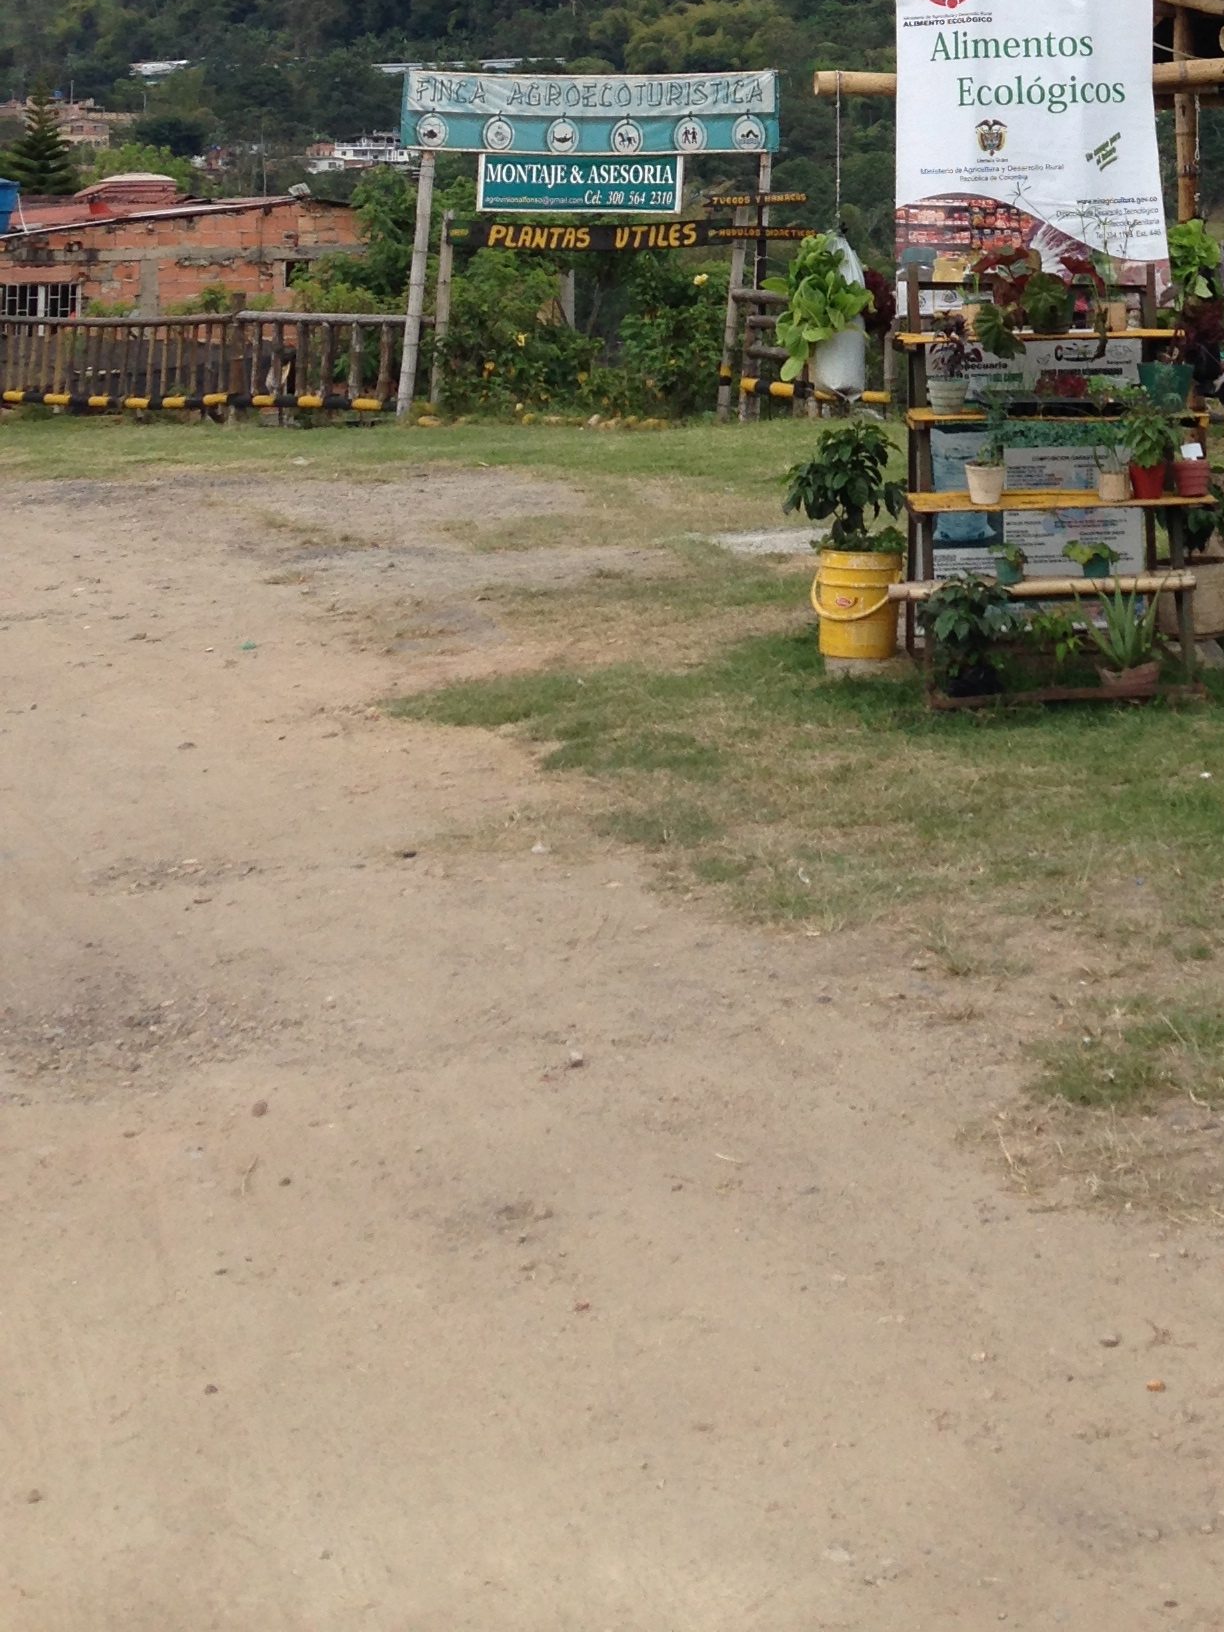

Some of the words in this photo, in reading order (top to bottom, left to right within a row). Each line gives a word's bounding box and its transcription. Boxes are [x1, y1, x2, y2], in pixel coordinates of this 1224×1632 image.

[903, 19, 945, 28] ALIMENTO
[930, 30, 1094, 61] Alimentos
[416, 76, 486, 104] FINCA
[506, 78, 763, 107] AGROECOTURISTICA
[957, 75, 1126, 114] Ecológicos
[486, 163, 567, 188] MONTAJE
[570, 164, 585, 184] &
[587, 163, 675, 185] ASESORIA
[1045, 163, 1065, 171] Rural
[606, 190, 625, 205] 300
[628, 190, 646, 206] 564
[650, 190, 673, 205] 2310
[486, 224, 591, 249] PLANTAS
[615, 223, 697, 249] UTILES
